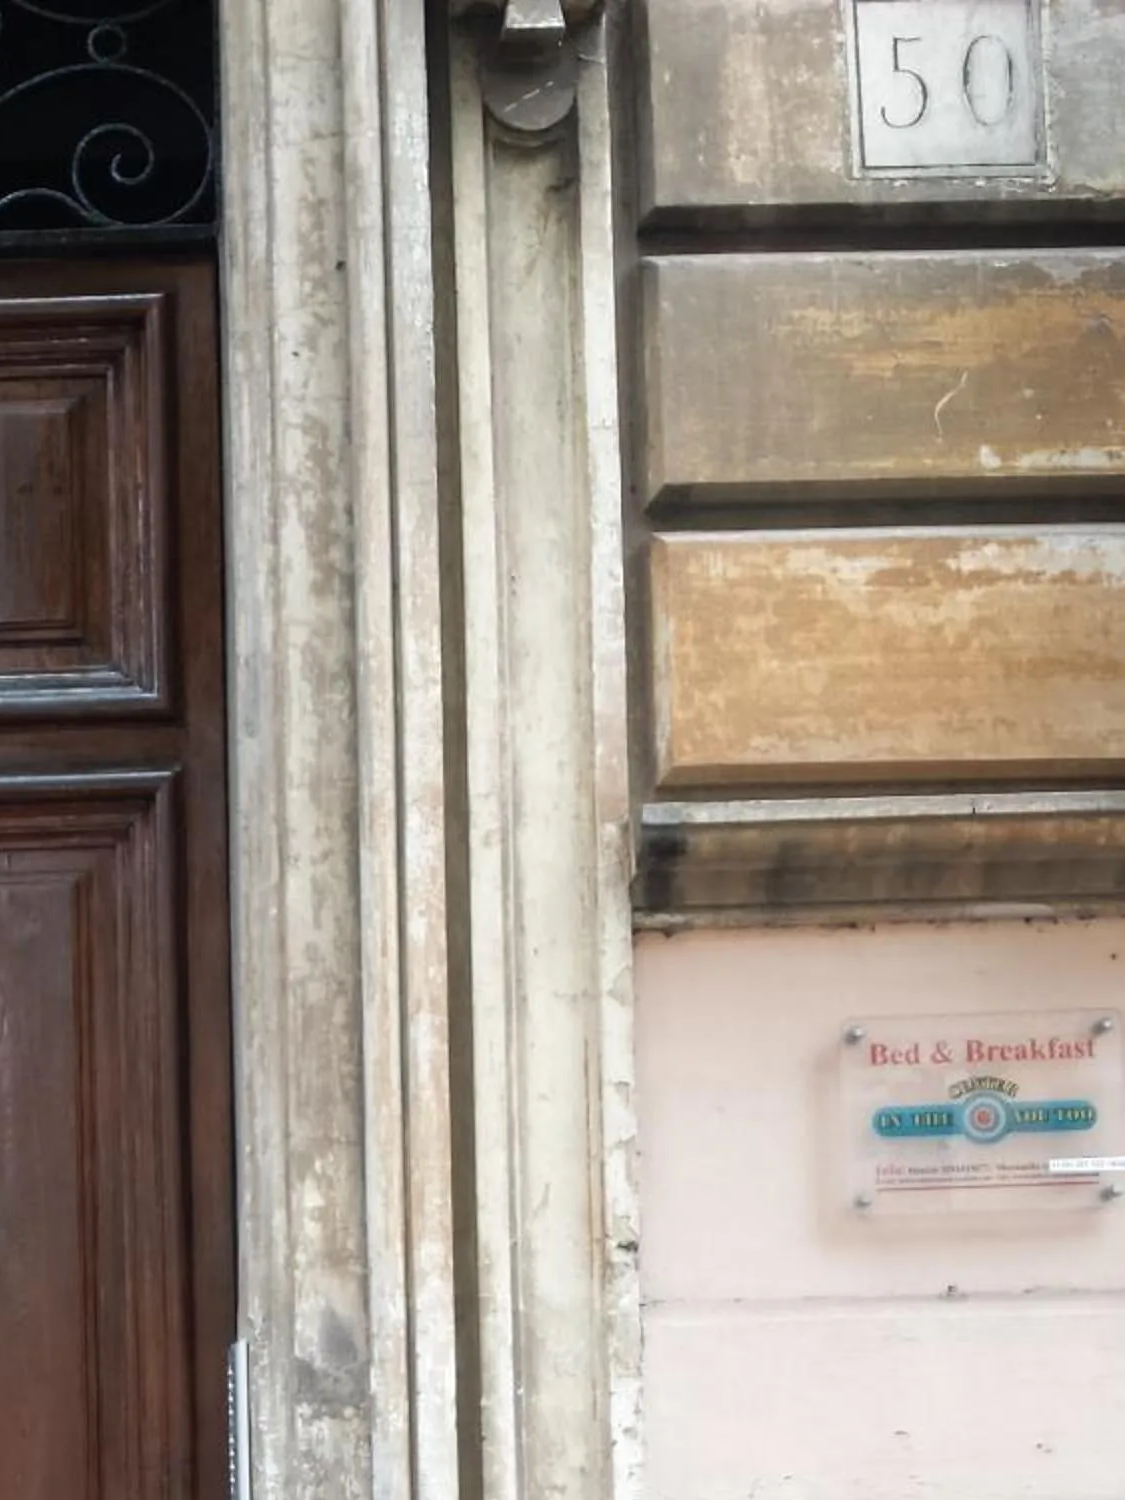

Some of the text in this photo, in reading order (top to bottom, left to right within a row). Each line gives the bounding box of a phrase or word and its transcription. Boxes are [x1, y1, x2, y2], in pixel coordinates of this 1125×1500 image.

[880, 34, 1013, 128] 50
[870, 1036, 1095, 1066] Bed & Breakfast
